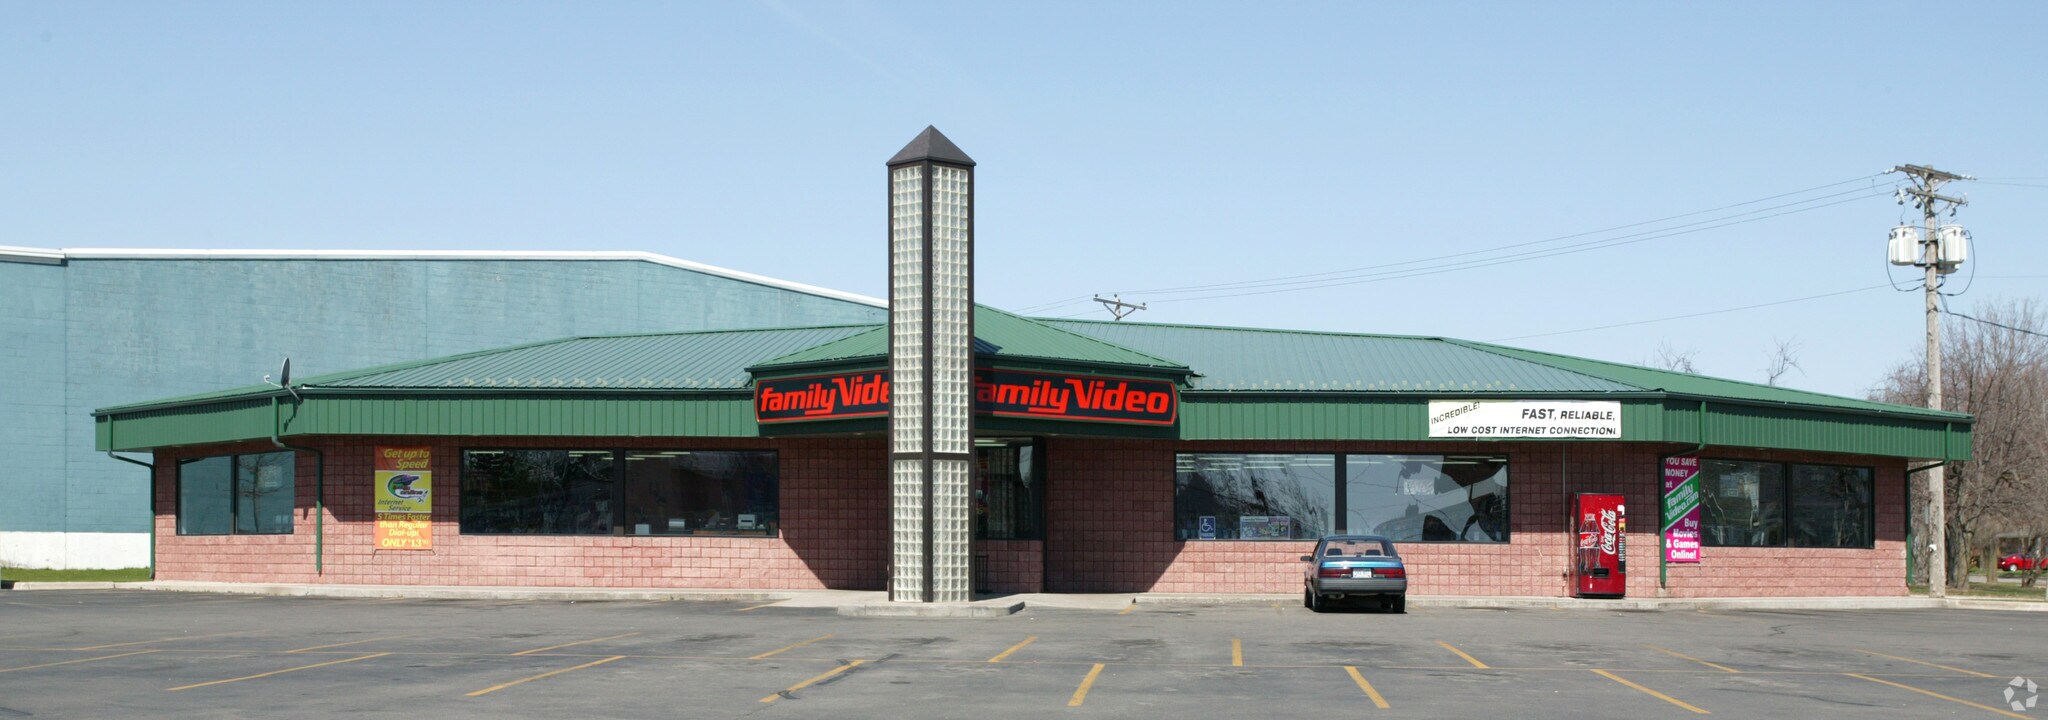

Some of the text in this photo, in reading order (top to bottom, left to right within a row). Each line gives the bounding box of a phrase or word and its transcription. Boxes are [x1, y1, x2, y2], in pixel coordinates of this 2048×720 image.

[831, 374, 889, 406] Vide
[1064, 378, 1169, 413] Video
[1431, 401, 1480, 424] INCREDIBLE!
[1521, 408, 1615, 421] FAST, RELIABLE,
[1447, 426, 1616, 435] LOW COST INTERNET CONNECTION!
[384, 448, 430, 459] Get up to
[396, 459, 428, 470] Speed
[1665, 457, 1697, 466] YOU SAVE
[1665, 468, 1688, 477] MONEY
[1667, 483, 1694, 509] family
[384, 512, 406, 520] Times
[379, 520, 429, 530] than Regular
[1684, 518, 1698, 528] Buy
[1600, 508, 1617, 555] Coca-Cola
[1673, 529, 1698, 538] Movies
[382, 538, 406, 547] ONLY
[1666, 539, 1698, 548] & Games
[1671, 550, 1697, 559] Online!
